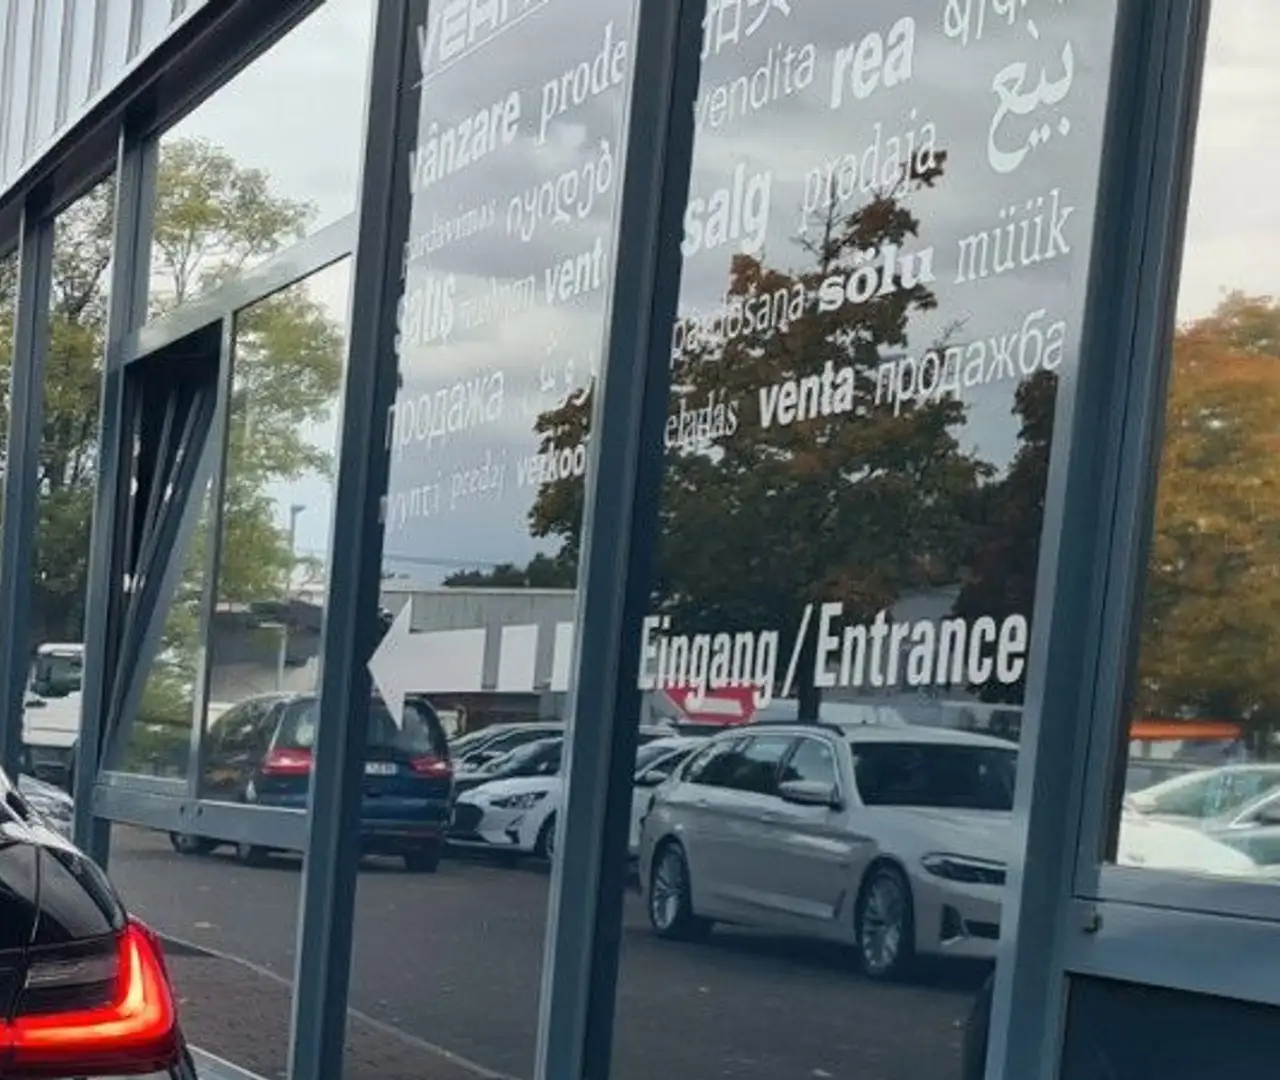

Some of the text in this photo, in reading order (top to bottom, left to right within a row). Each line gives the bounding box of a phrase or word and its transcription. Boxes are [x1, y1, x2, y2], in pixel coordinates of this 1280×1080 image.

[693, 39, 817, 133] vendita
[829, 15, 917, 109] rea
[987, 39, 1075, 173] بيع
[680, 108, 937, 258] salg prodaja
[953, 187, 1075, 286] müük
[816, 240, 935, 313] sölu
[758, 359, 855, 429] venta
[873, 308, 1067, 418] продажба
[637, 614, 779, 710] Eingang
[813, 601, 1030, 689] Entrance
